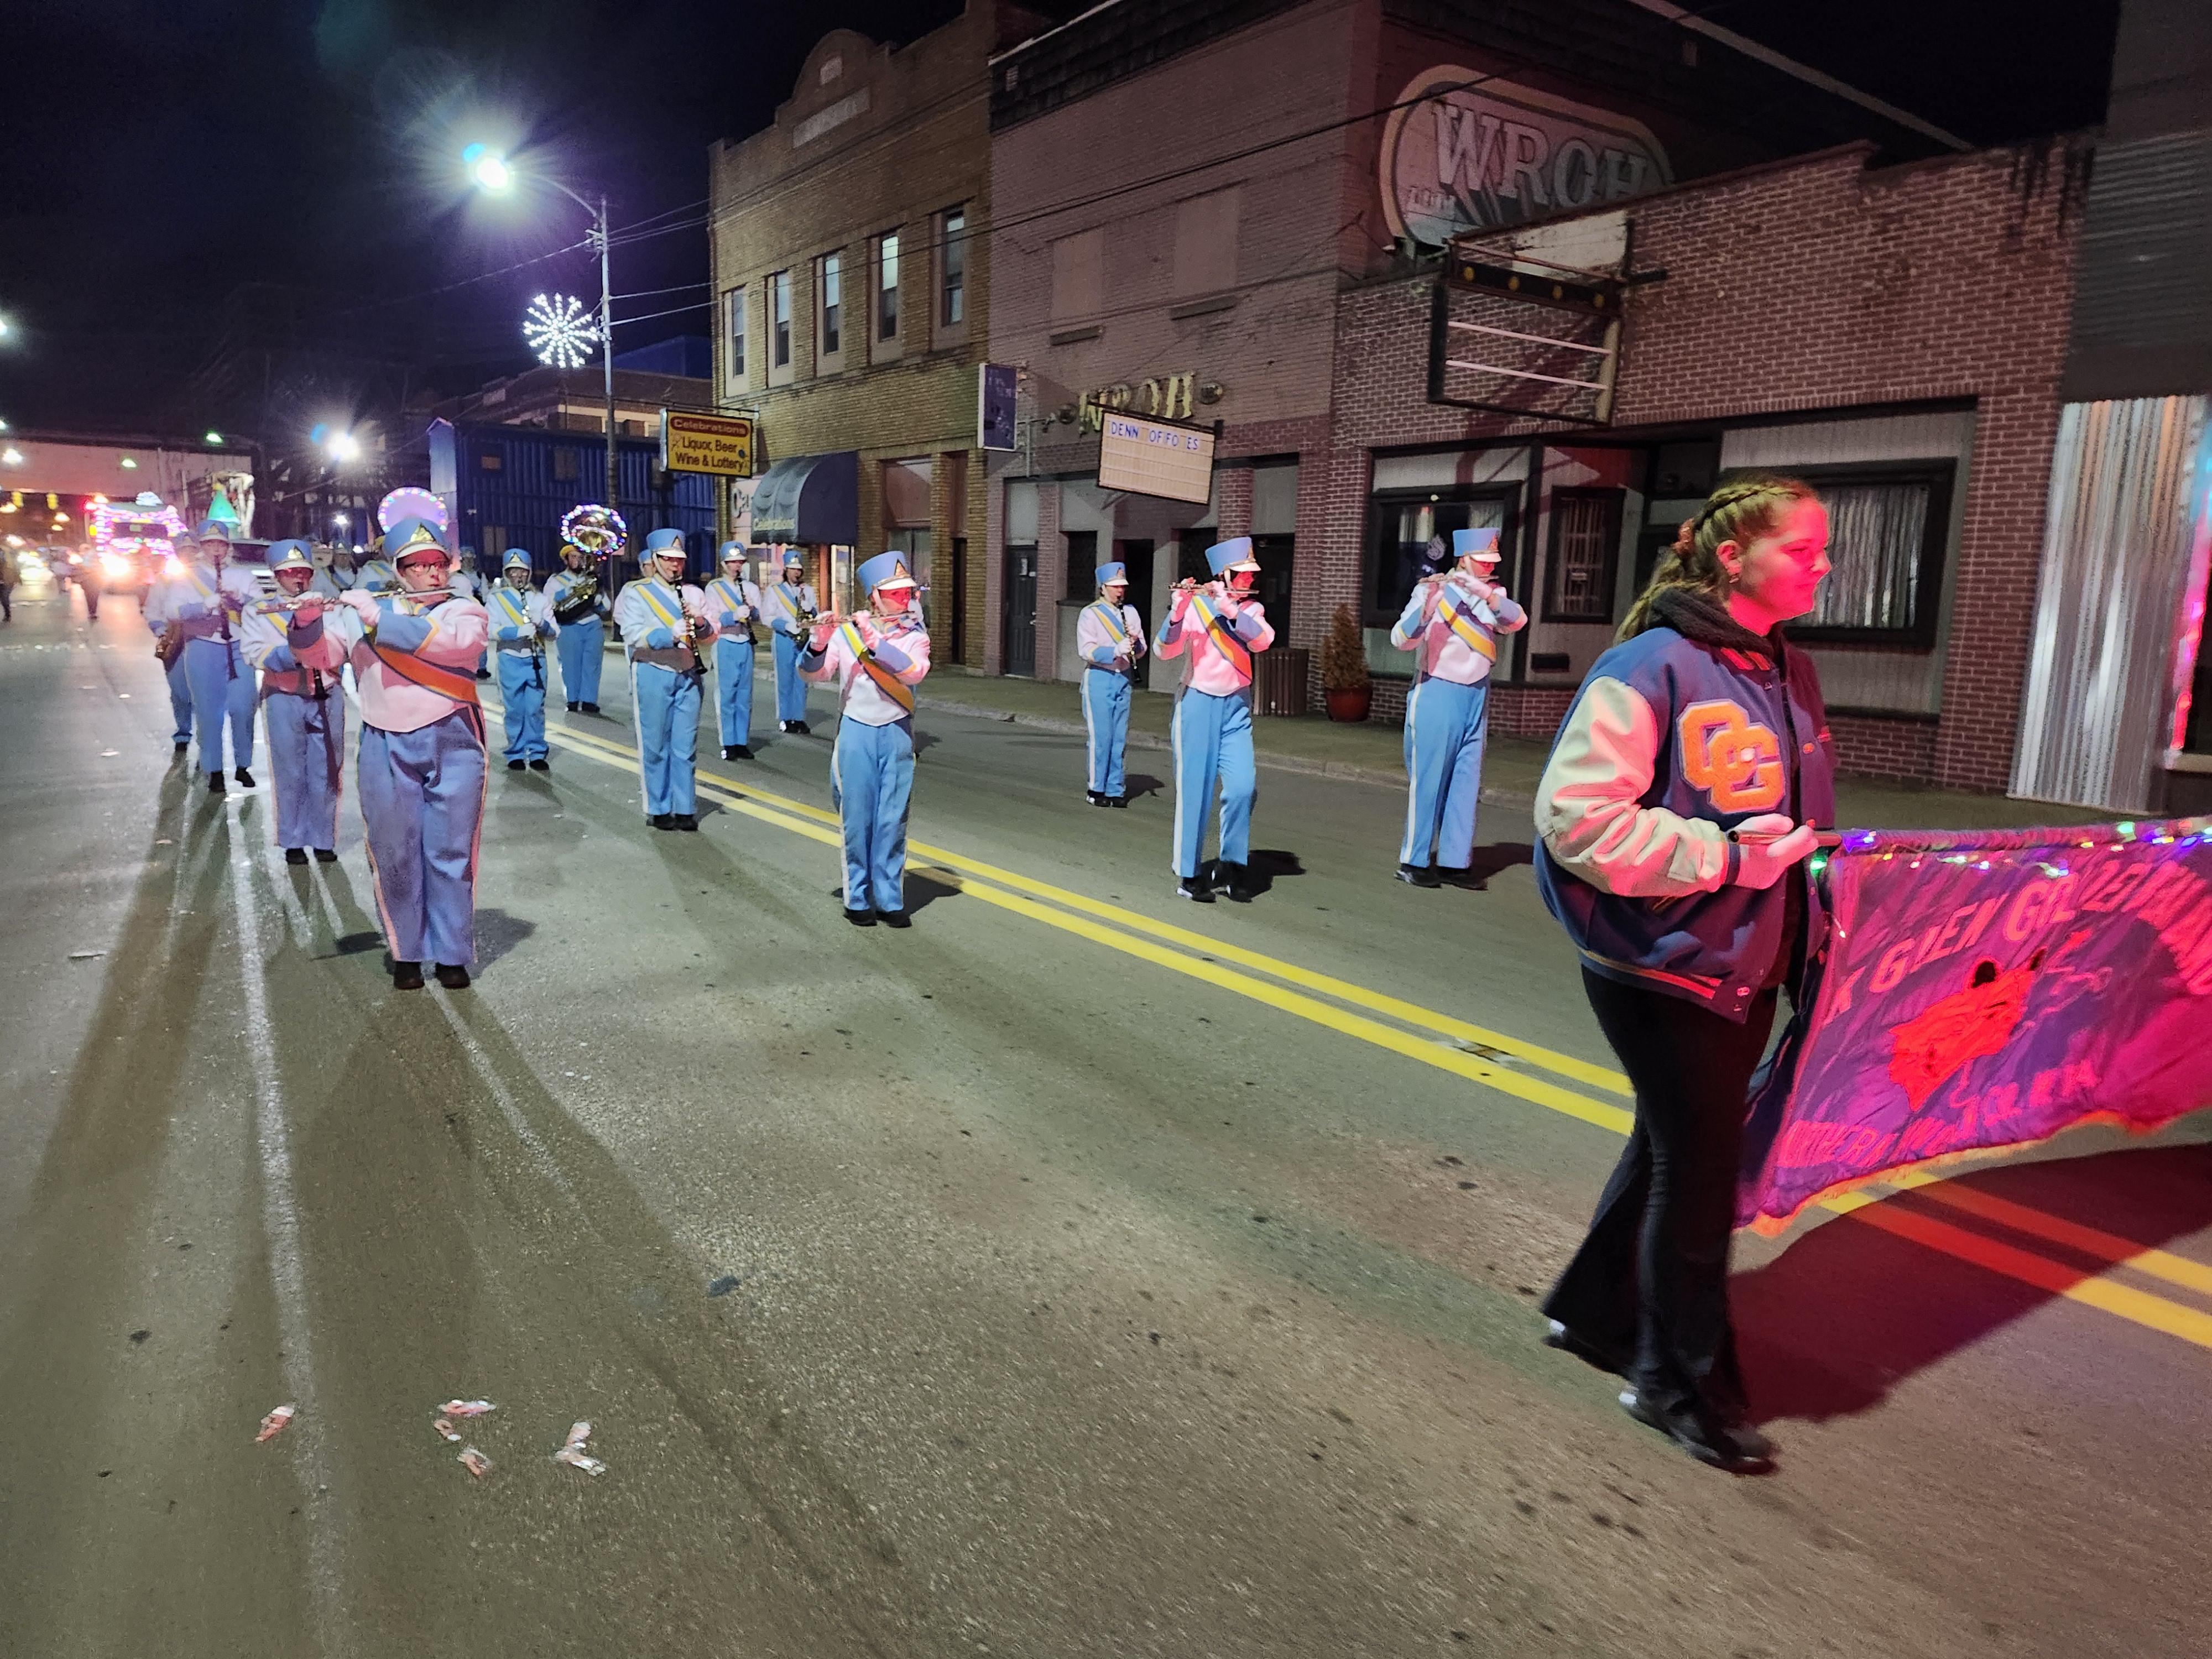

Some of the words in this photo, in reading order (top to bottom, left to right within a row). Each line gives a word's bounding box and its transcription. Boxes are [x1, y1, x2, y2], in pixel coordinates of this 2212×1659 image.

[674, 419, 746, 435] Celebrations
[1111, 421, 1139, 439] DENN
[682, 436, 713, 452] Liquor,
[715, 439, 738, 453] Beer
[675, 452, 700, 466] Wine
[702, 455, 709, 467] &
[711, 455, 744, 473] Lottery
